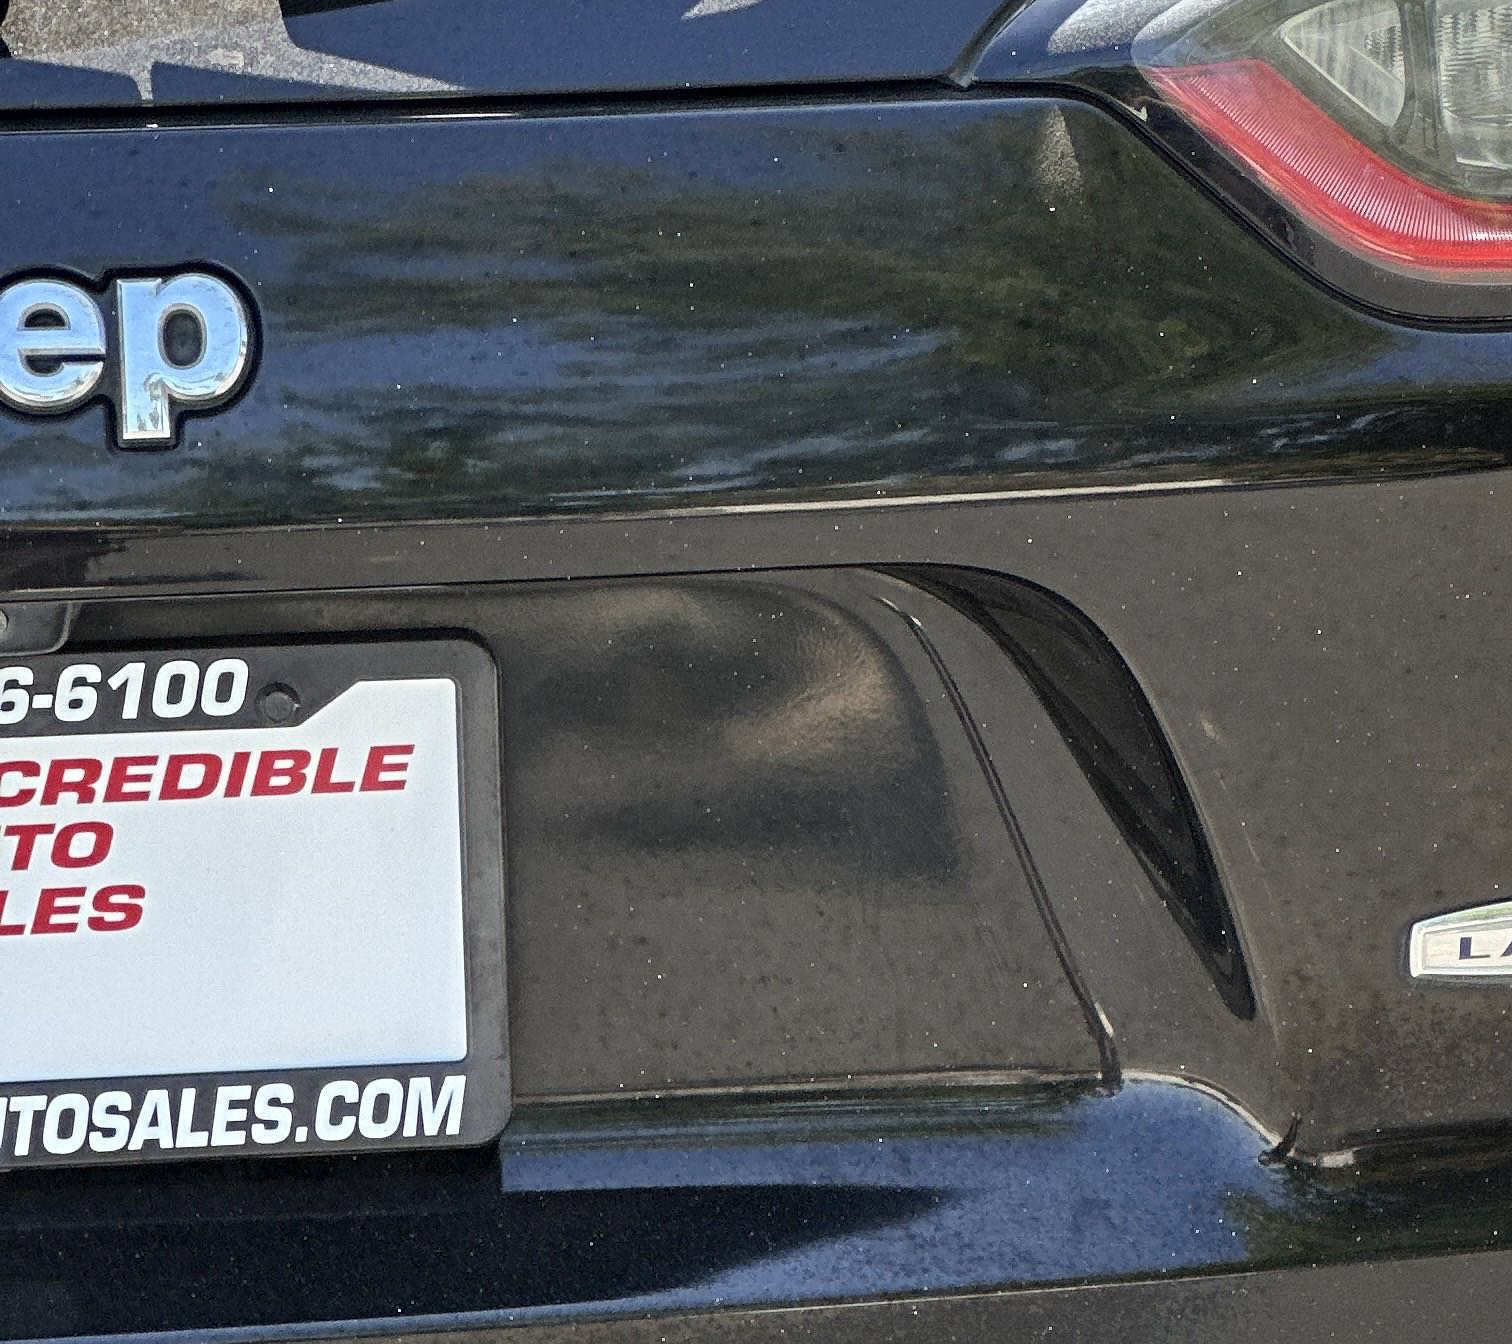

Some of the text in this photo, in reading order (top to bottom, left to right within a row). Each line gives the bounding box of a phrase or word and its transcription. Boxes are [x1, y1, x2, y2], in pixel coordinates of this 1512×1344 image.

[0, 272, 248, 440] ep
[0, 658, 249, 725] 6-6100
[0, 744, 414, 808] CREDIBLE
[0, 1074, 467, 1157] TOSALES.COM
